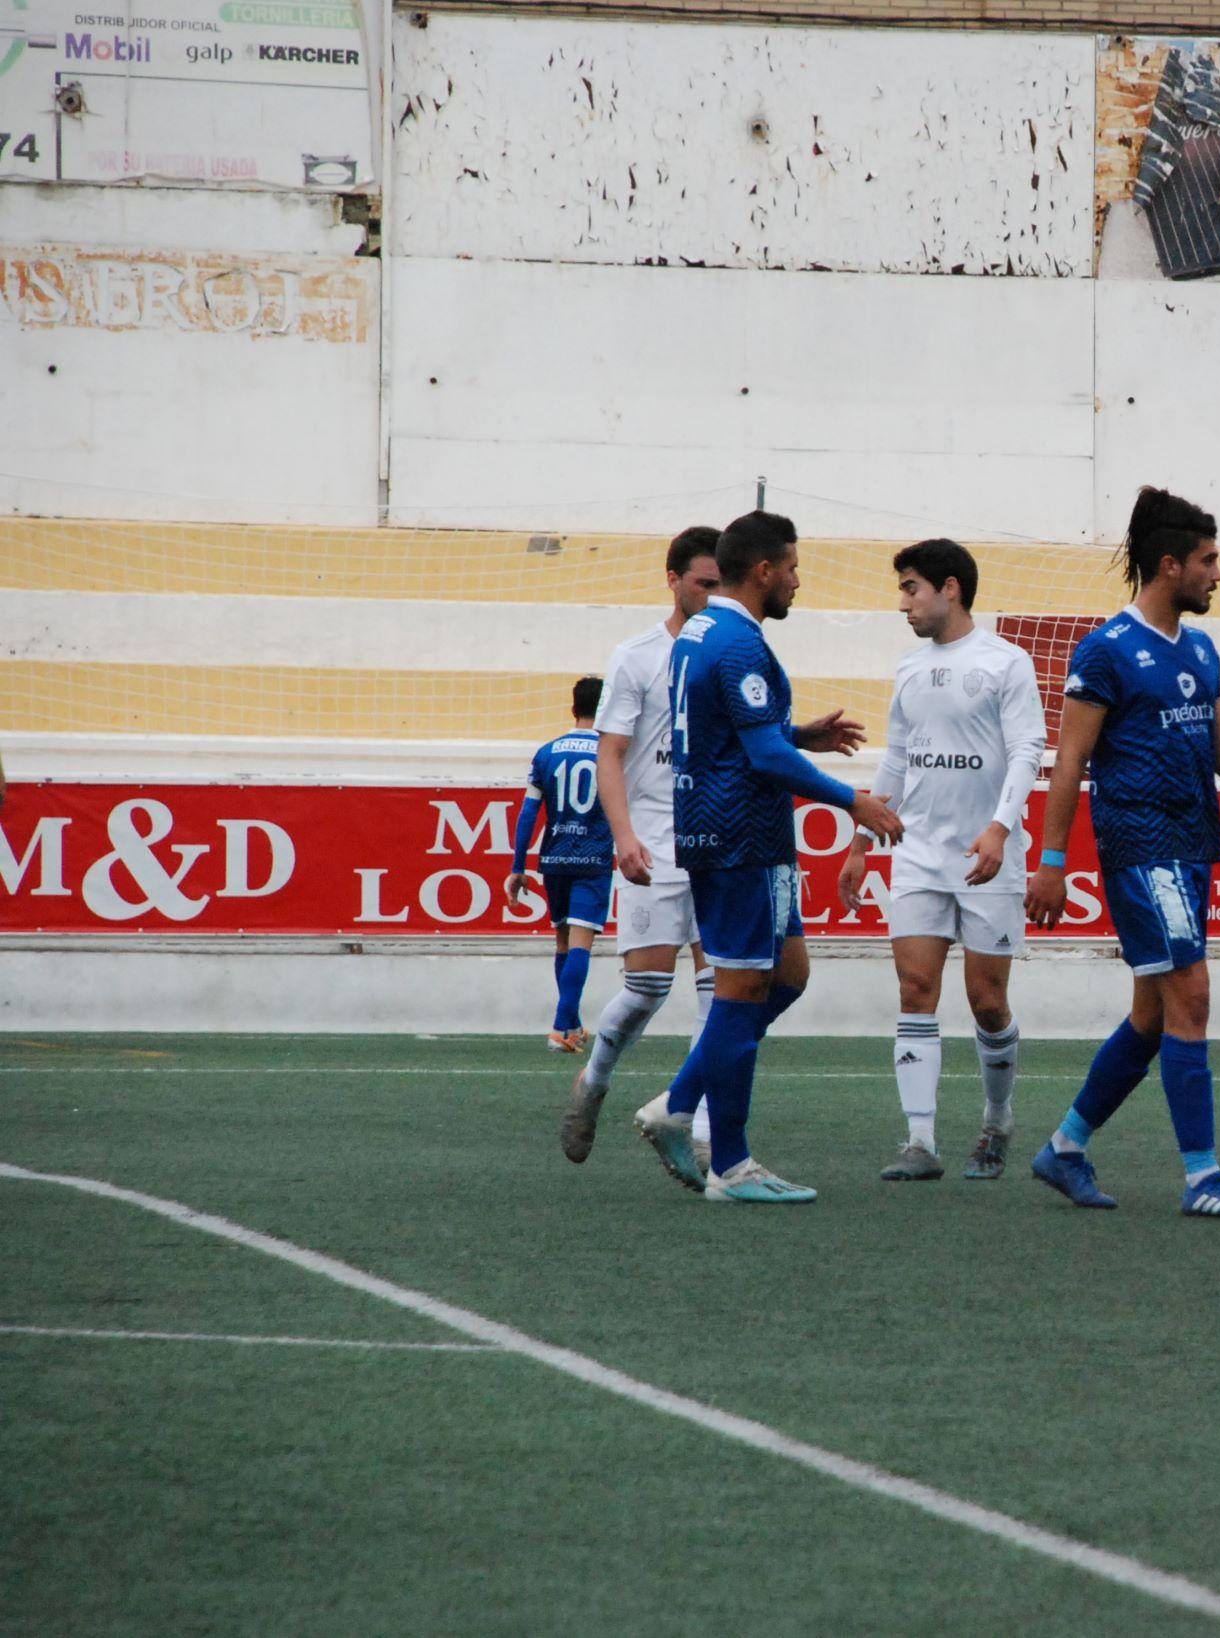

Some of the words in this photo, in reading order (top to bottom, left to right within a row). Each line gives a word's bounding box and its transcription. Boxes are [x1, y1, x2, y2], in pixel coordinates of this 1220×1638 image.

[170, 19, 222, 32] OFICIAL
[65, 33, 151, 62] Mobil
[186, 43, 233, 64] galp
[259, 44, 359, 65] KÄRCHER
[554, 759, 597, 814] 10
[353, 868, 547, 924] LOS
